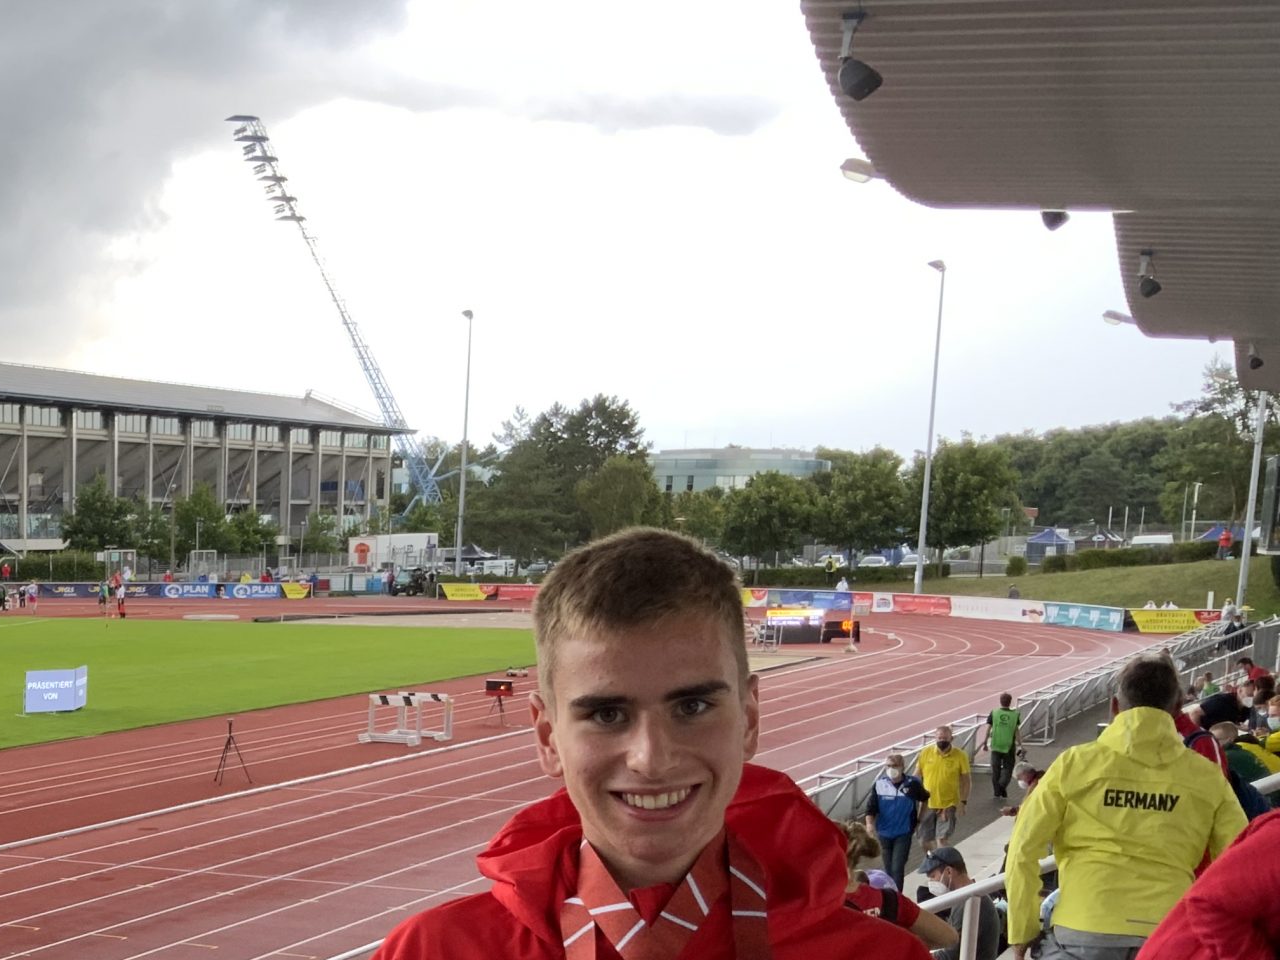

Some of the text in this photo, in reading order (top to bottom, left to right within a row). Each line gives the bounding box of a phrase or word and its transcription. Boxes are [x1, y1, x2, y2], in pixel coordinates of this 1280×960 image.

[183, 585, 209, 593] PLAN
[252, 585, 277, 593] PLAN
[27, 680, 74, 690] PRÄSENTIERT
[43, 692, 58, 700] VON
[1103, 788, 1180, 812] GERMANY
